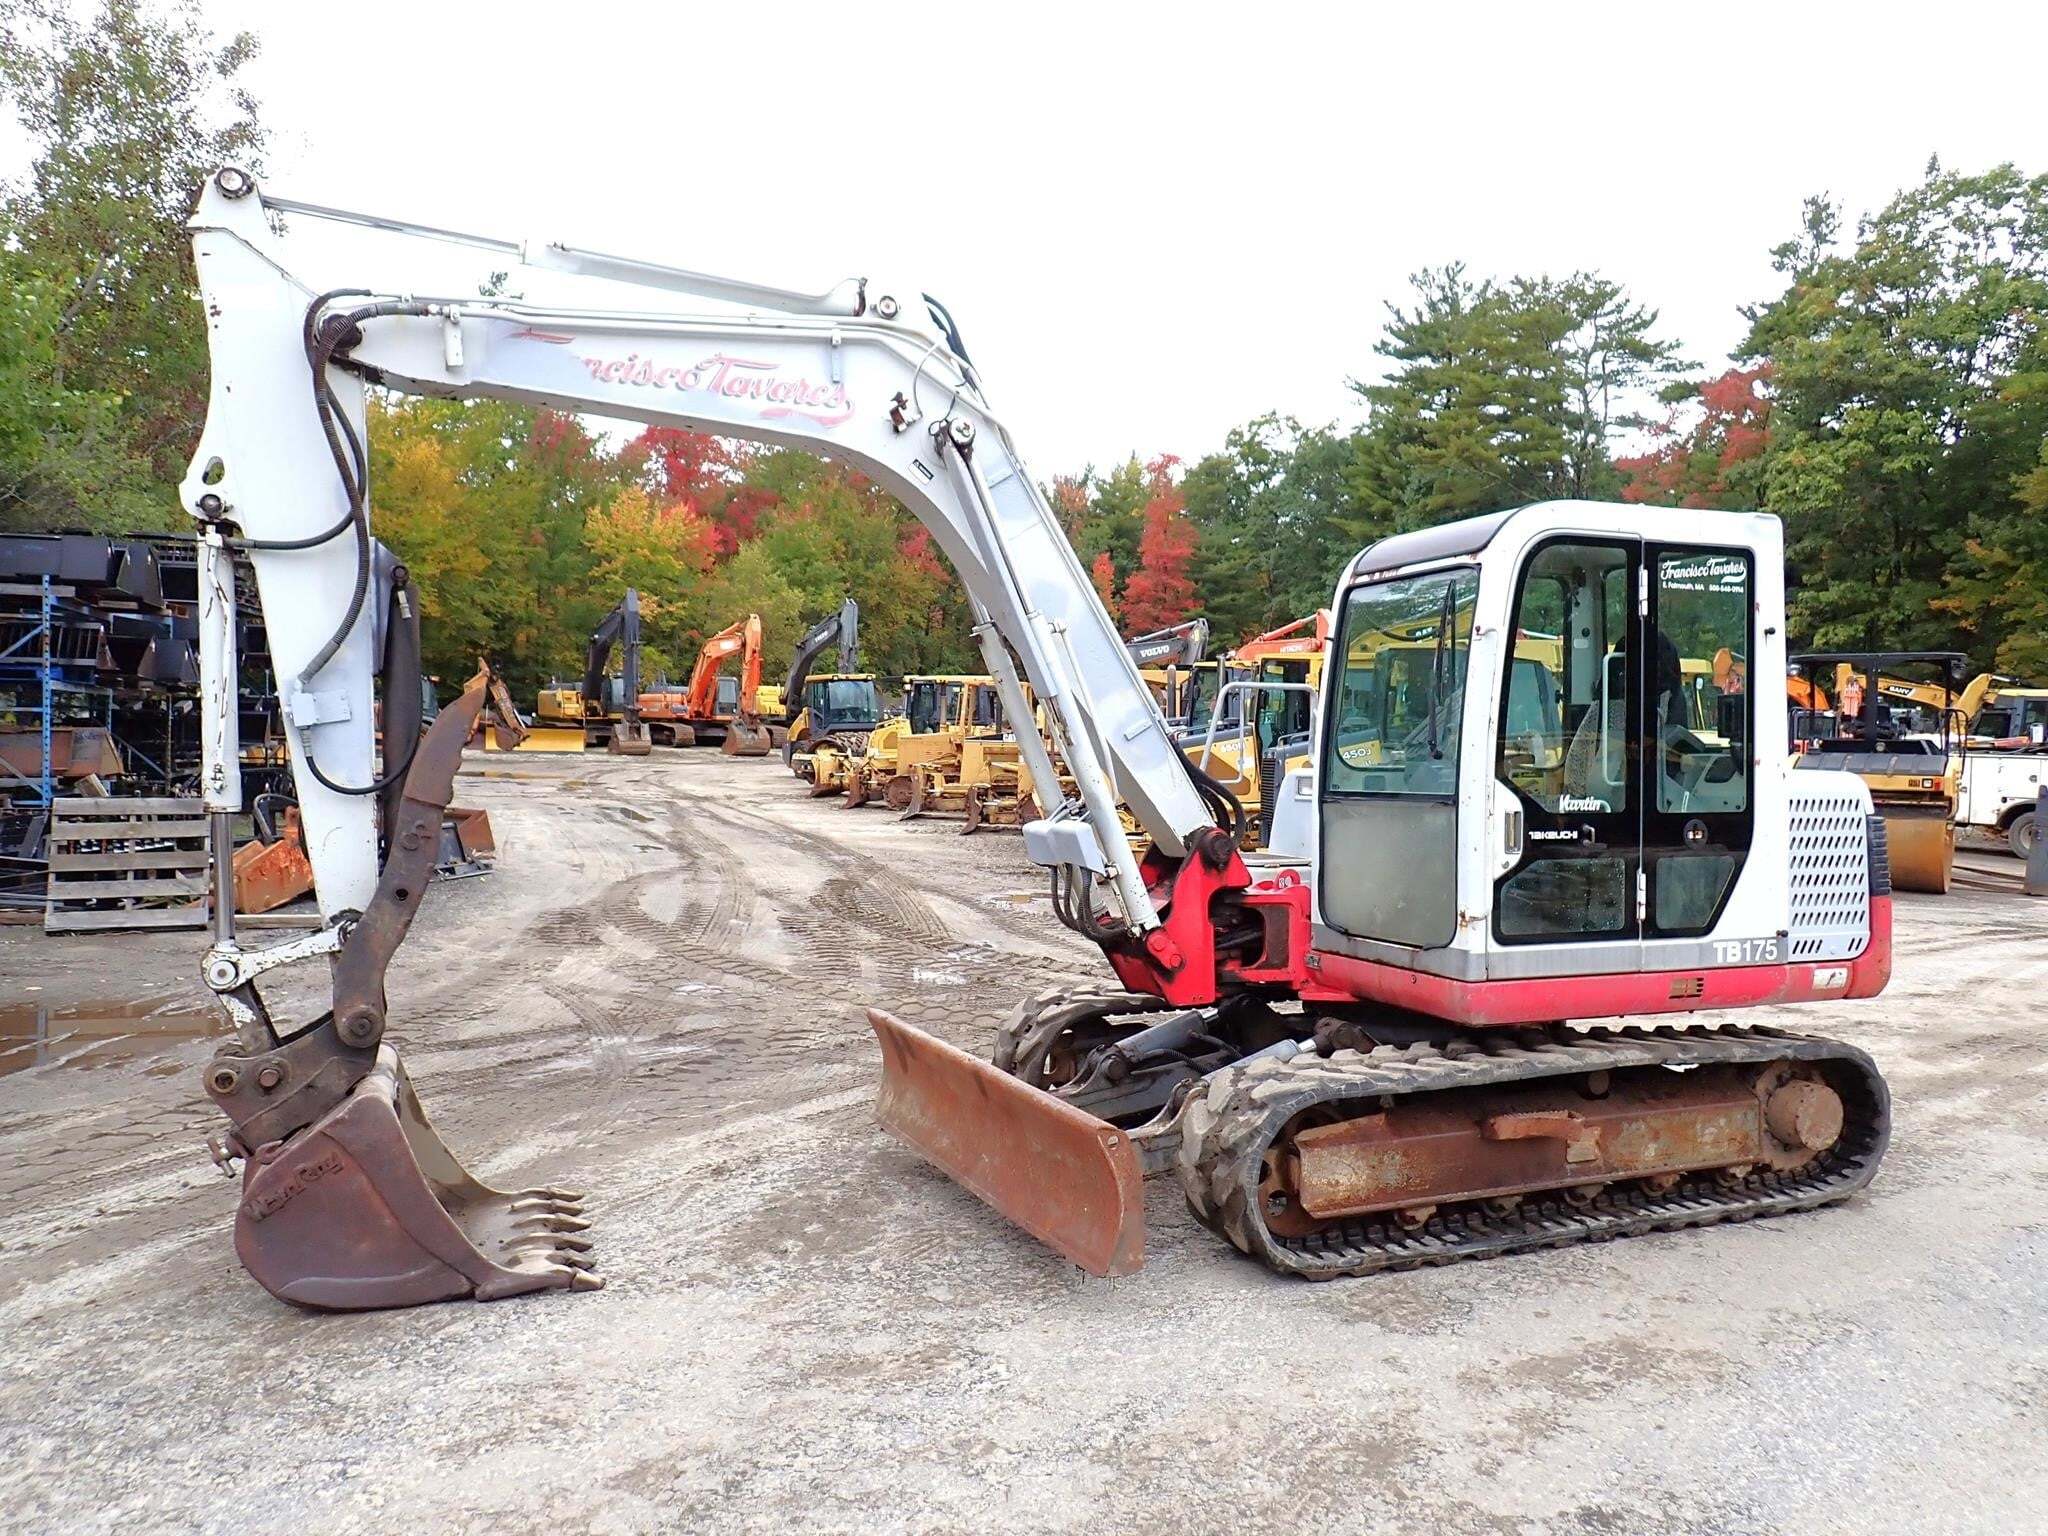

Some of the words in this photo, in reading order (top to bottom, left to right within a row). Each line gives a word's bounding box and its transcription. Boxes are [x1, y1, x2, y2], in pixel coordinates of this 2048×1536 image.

[1661, 560, 1709, 580] Francisco
[1706, 557, 1747, 583] Tavares
[1140, 645, 1170, 658] VOLVO
[1558, 794, 1601, 813] Martin
[1528, 831, 1578, 840] TAKEUCHI
[1712, 939, 1778, 963] TB175
